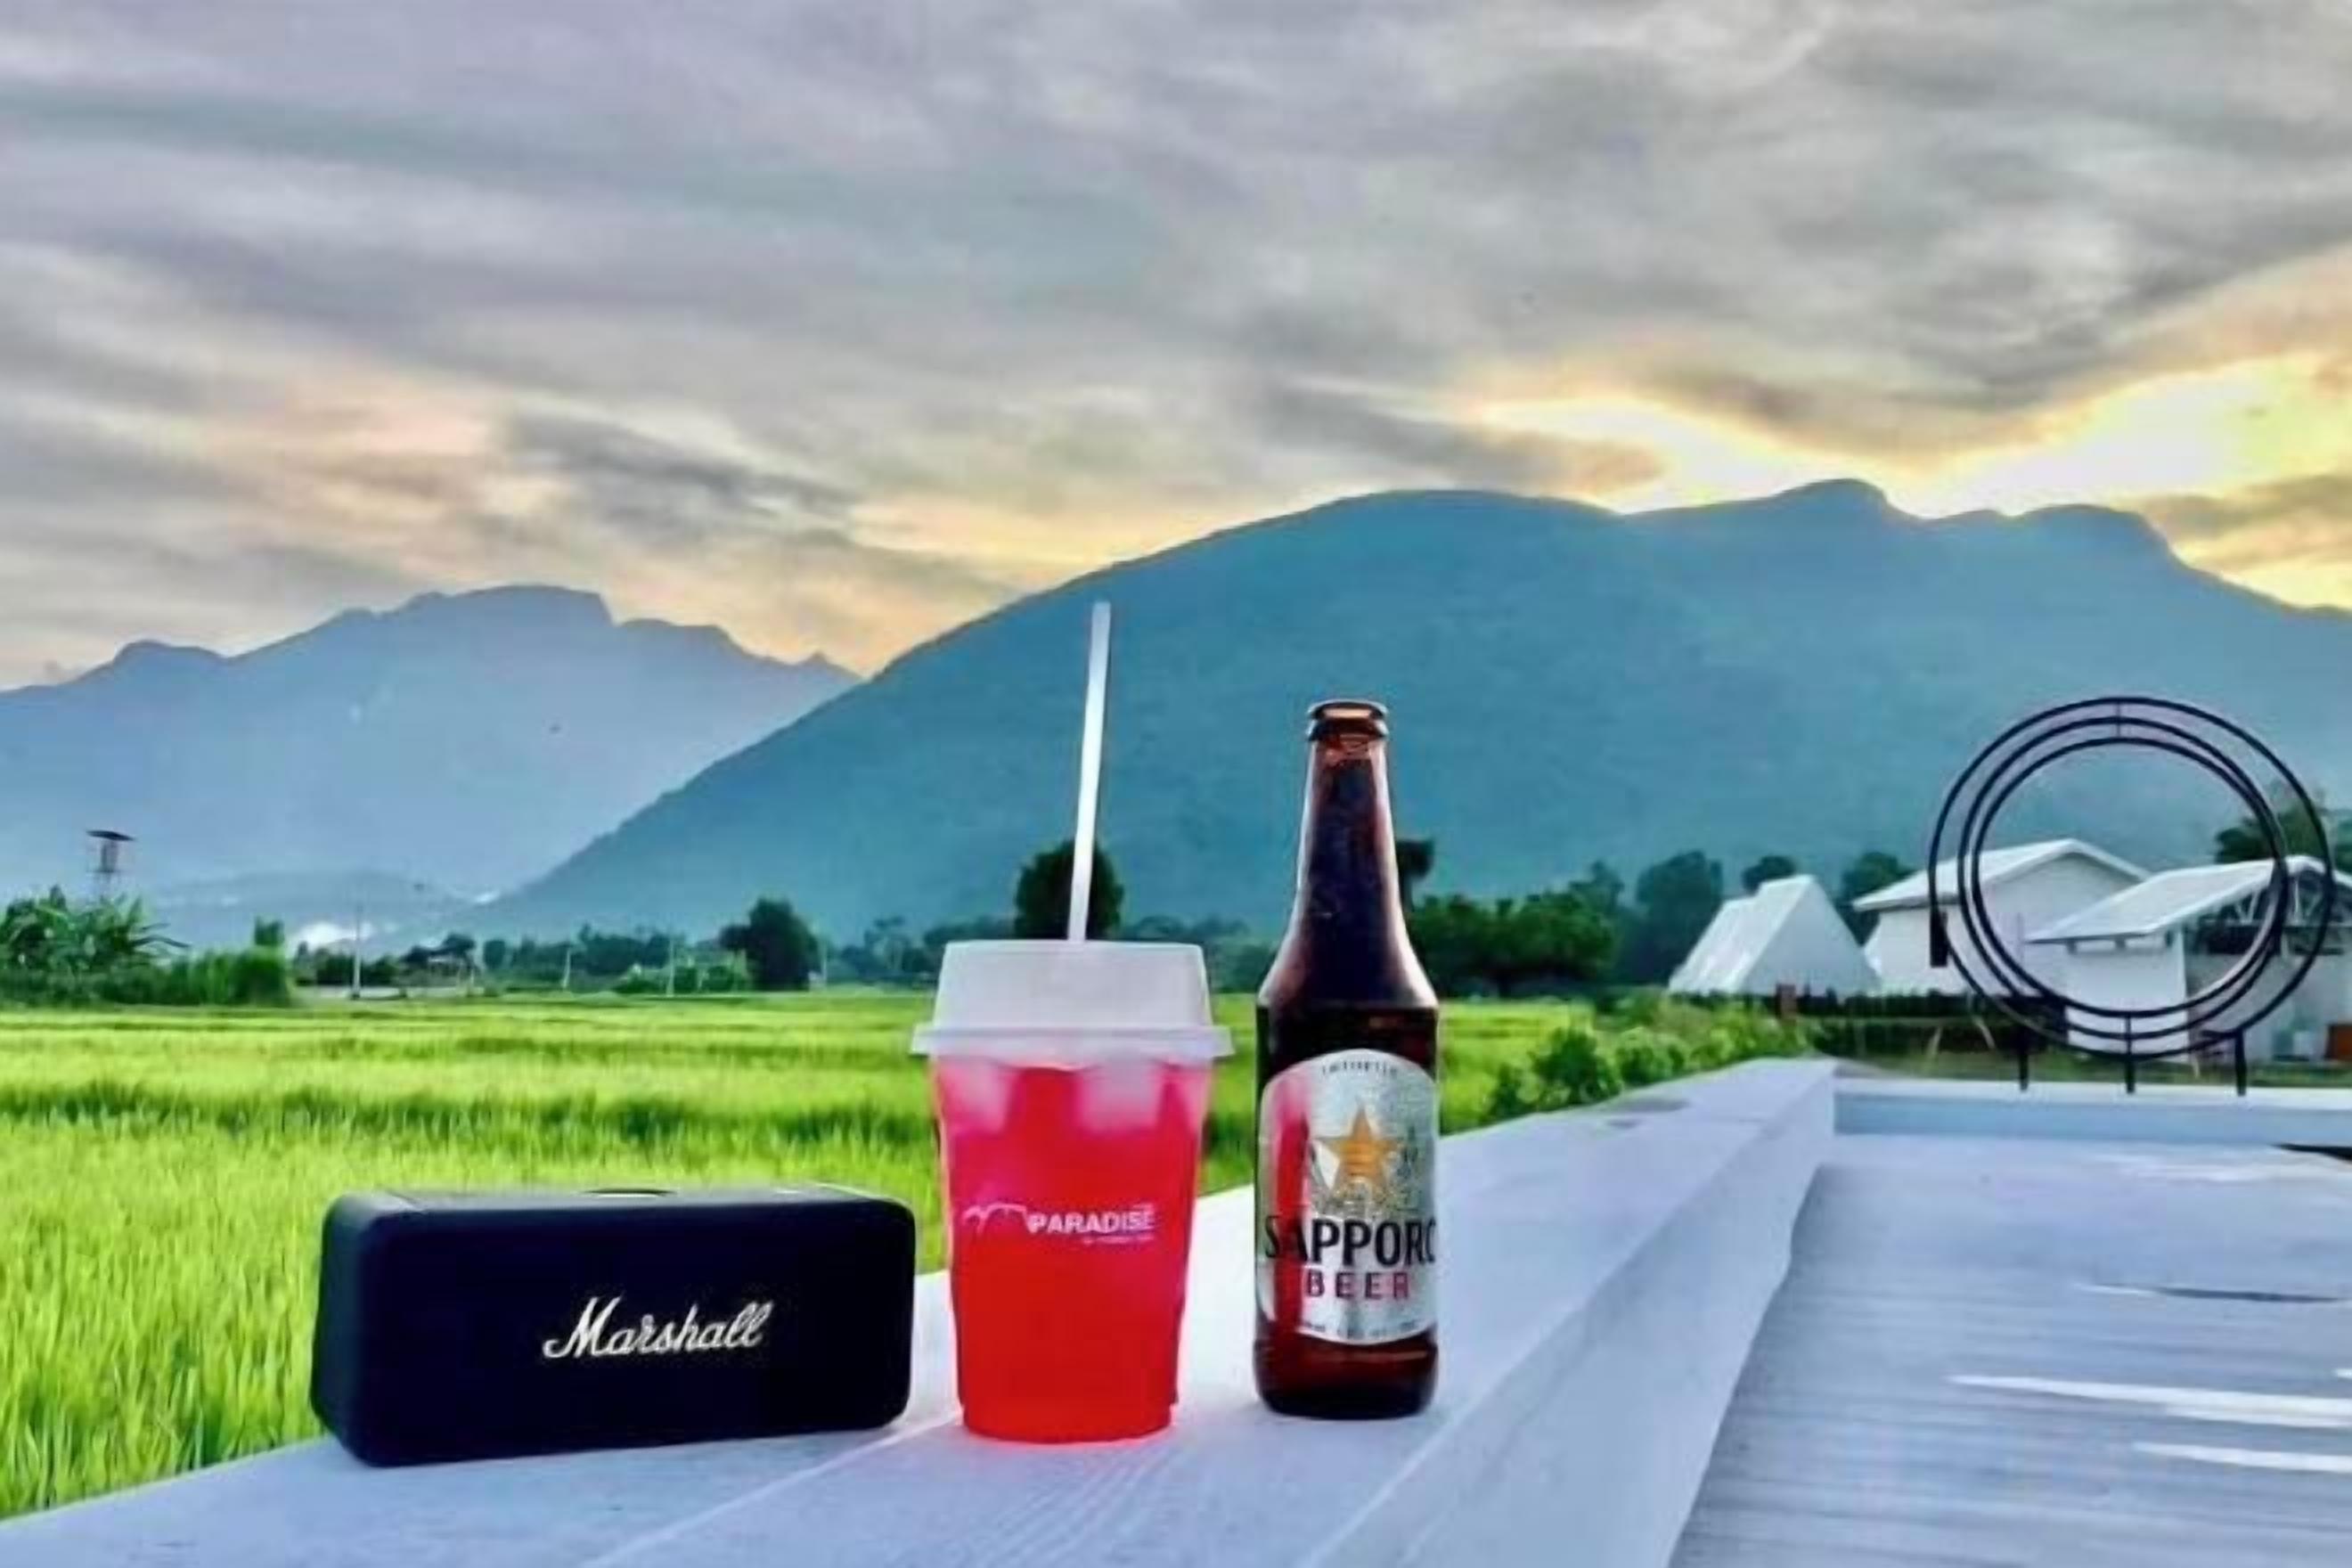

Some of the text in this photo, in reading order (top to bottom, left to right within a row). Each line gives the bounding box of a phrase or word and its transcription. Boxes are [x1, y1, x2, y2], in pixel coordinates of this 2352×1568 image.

[1027, 1211, 1154, 1234] PARADISE
[1306, 1271, 1409, 1299] BEER
[543, 1294, 773, 1358] Marshall
